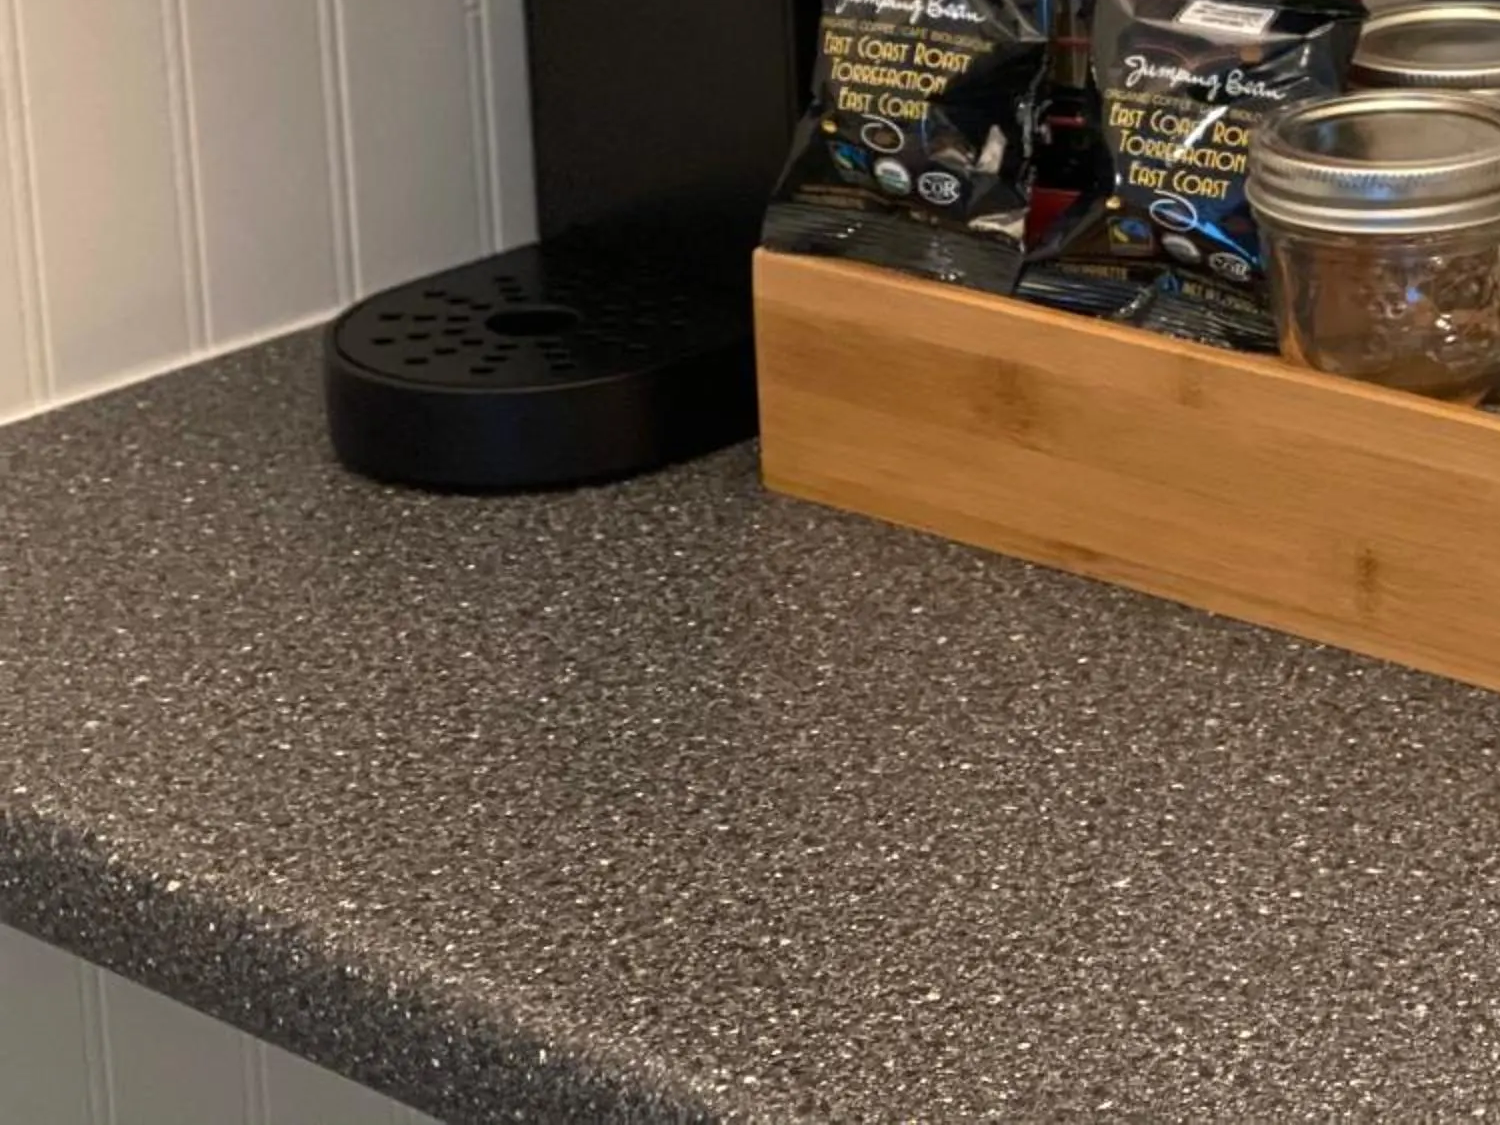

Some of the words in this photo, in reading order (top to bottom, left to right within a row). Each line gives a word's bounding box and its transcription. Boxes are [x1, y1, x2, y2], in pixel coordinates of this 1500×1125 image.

[823, 30, 853, 56] EAST
[857, 35, 910, 63] COAST
[913, 42, 972, 74] ROAST
[1123, 55, 1222, 102] Jumping
[1225, 68, 1287, 101] Bean
[838, 86, 873, 111] EAST
[878, 92, 931, 121] COAST
[1109, 102, 1146, 129] EAST
[1128, 160, 1168, 189] EAST
[1173, 170, 1231, 200] COAST
